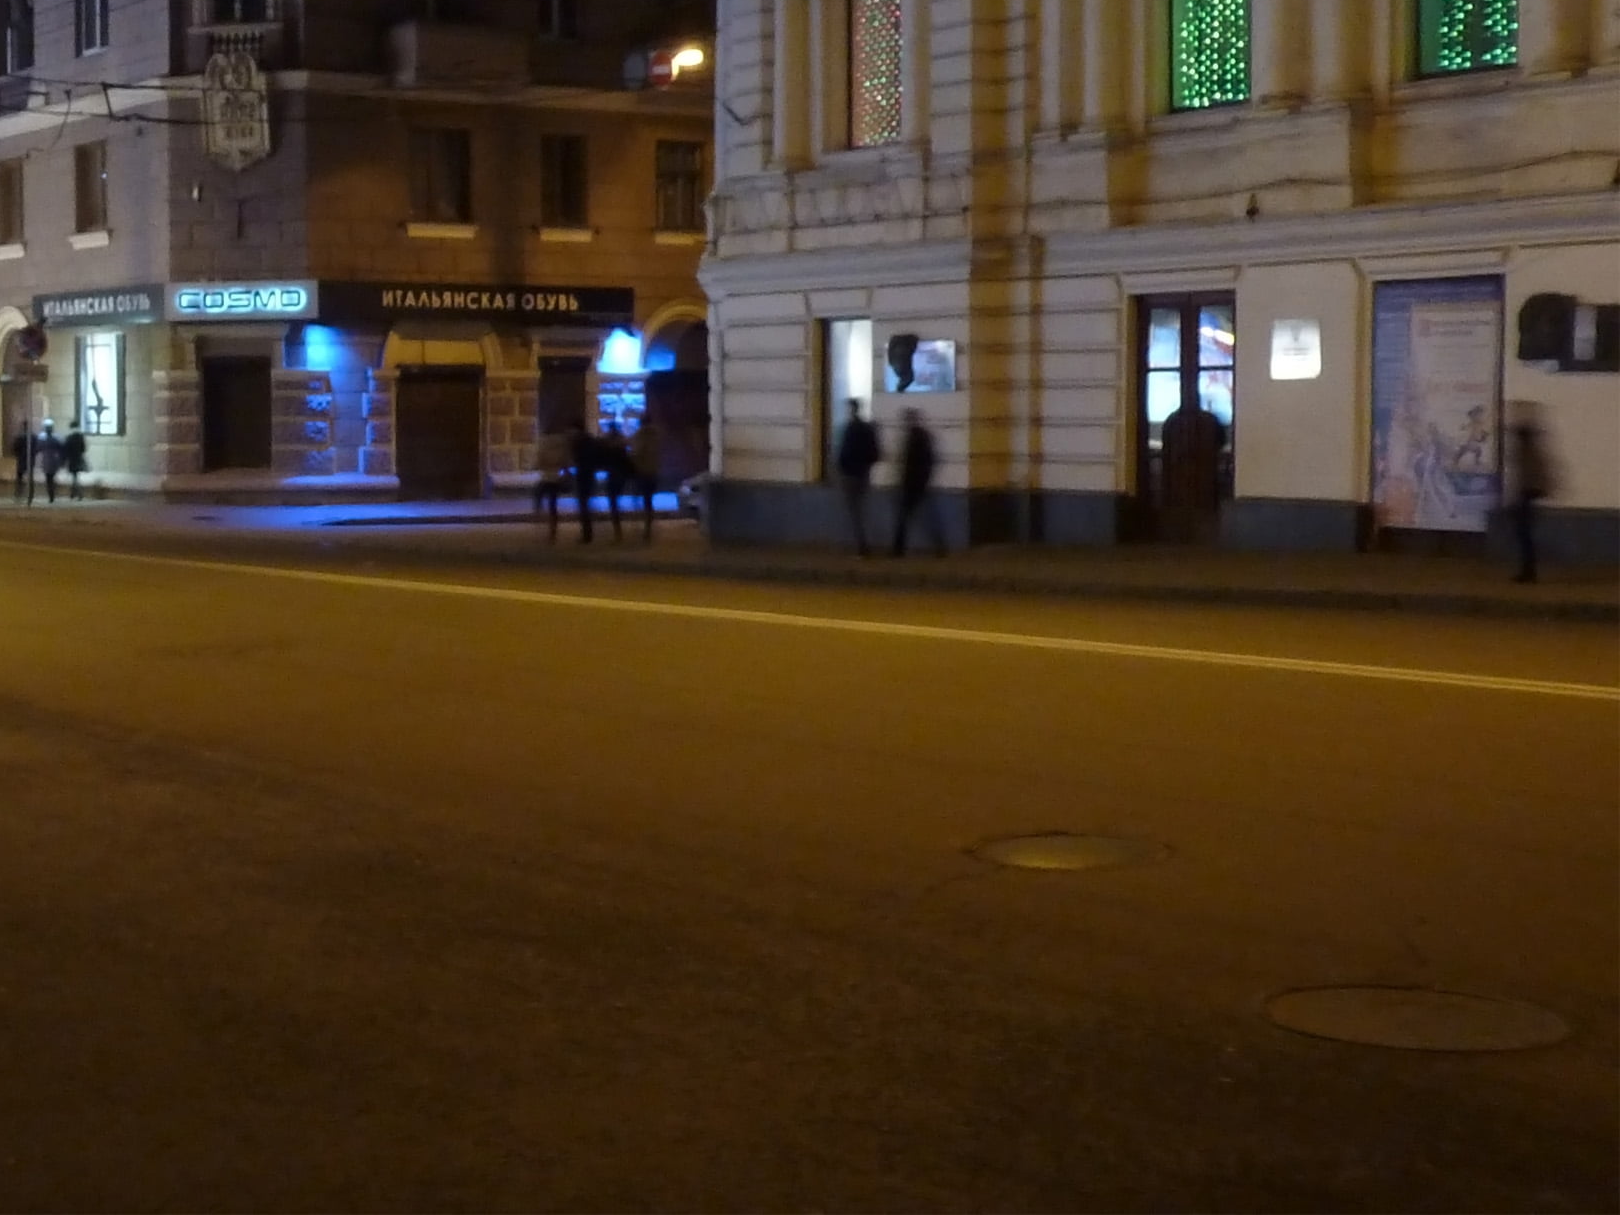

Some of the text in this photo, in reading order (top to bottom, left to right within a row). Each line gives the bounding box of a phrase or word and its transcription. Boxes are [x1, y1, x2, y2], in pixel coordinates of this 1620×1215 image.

[42, 293, 151, 317] ИТАЛЬЯНСКАЯ ОБУВЬ
[178, 288, 305, 311] COSMO
[382, 290, 579, 311] ИТАЛЬЯНСКАЯ ОБУВЬ
